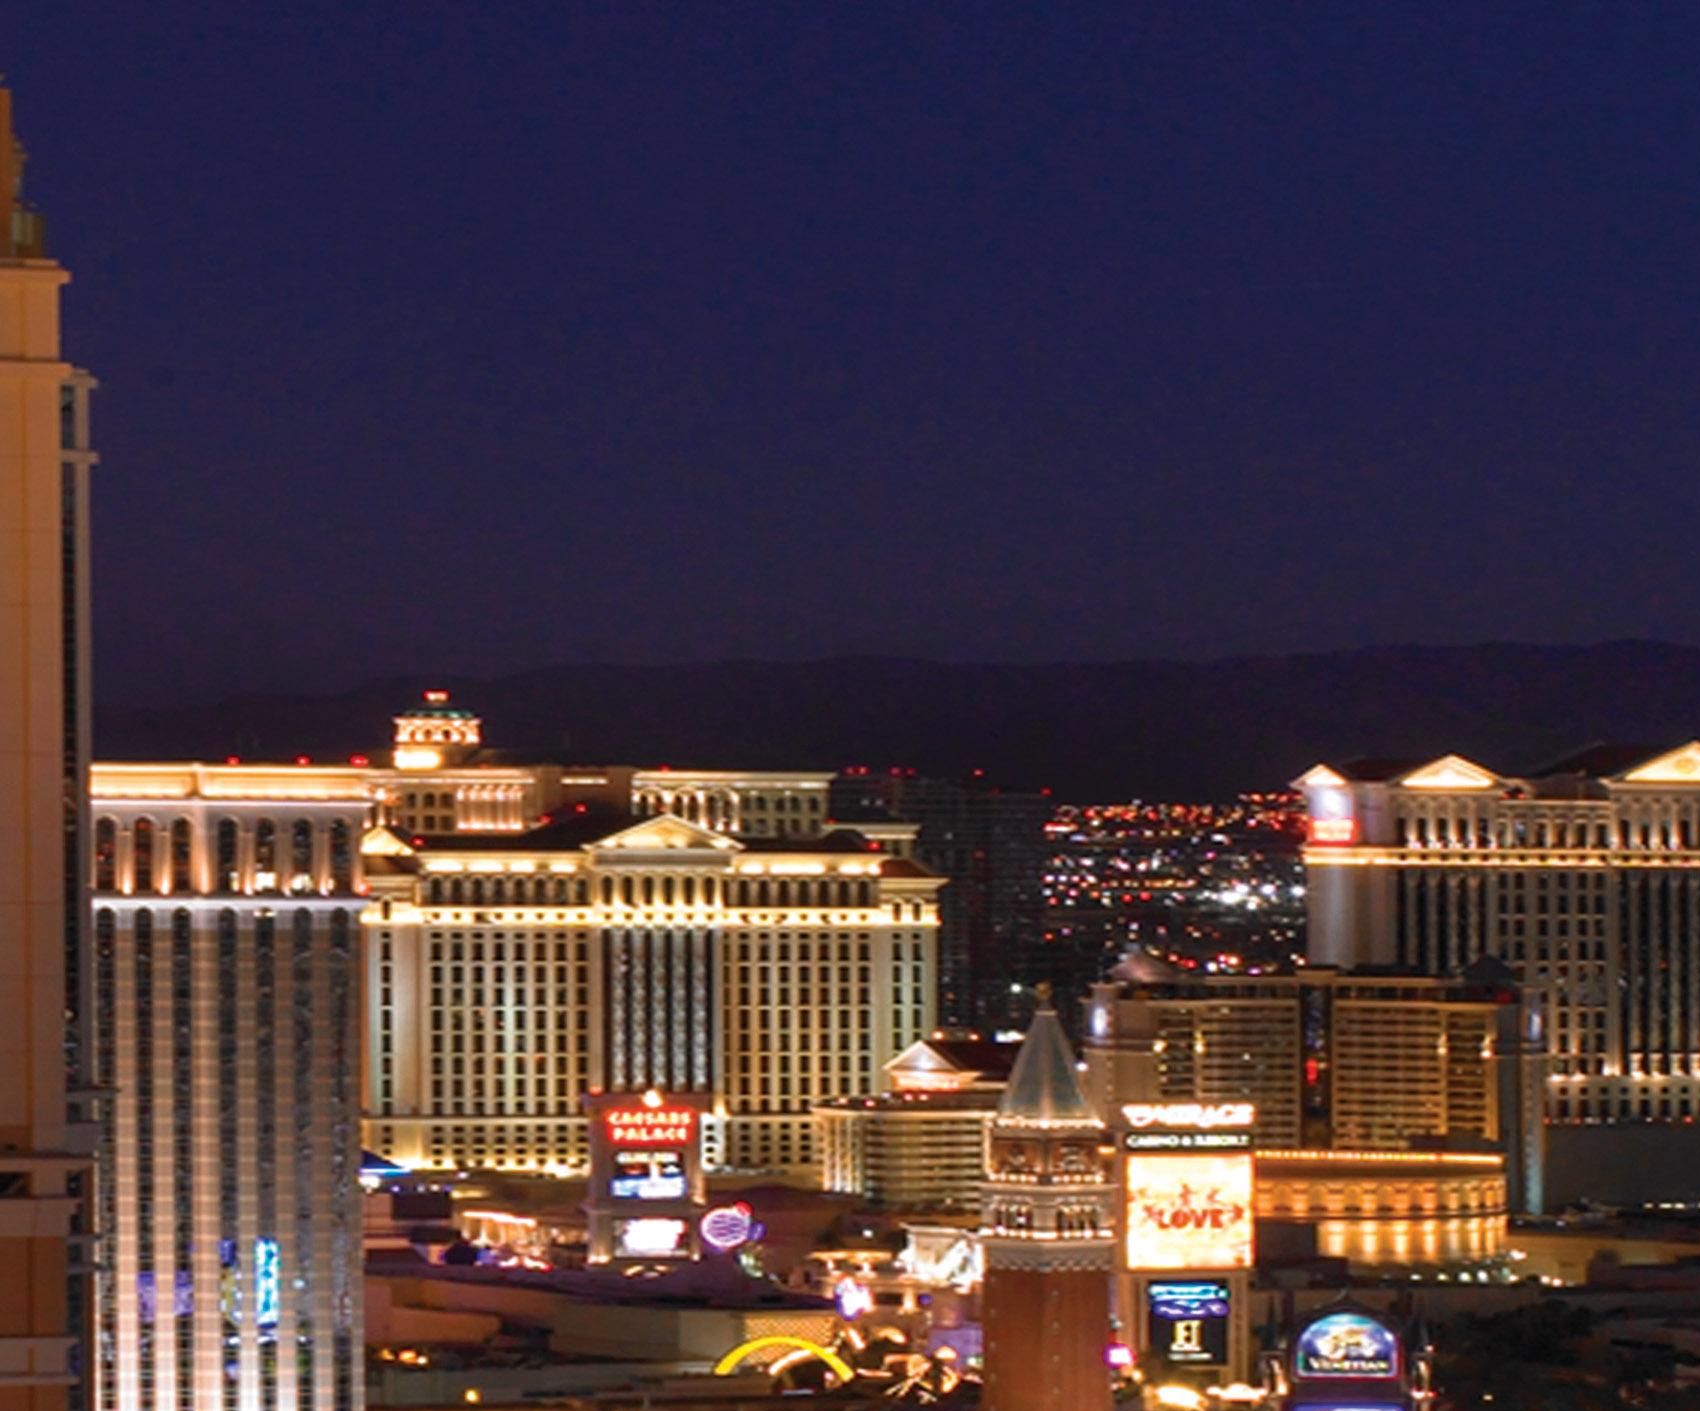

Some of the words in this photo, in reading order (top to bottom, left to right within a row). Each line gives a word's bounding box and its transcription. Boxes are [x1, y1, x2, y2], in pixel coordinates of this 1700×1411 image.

[608, 1111, 691, 1125] CAESARS
[612, 1127, 687, 1141] PALACE
[1157, 1207, 1224, 1230] LOVE
